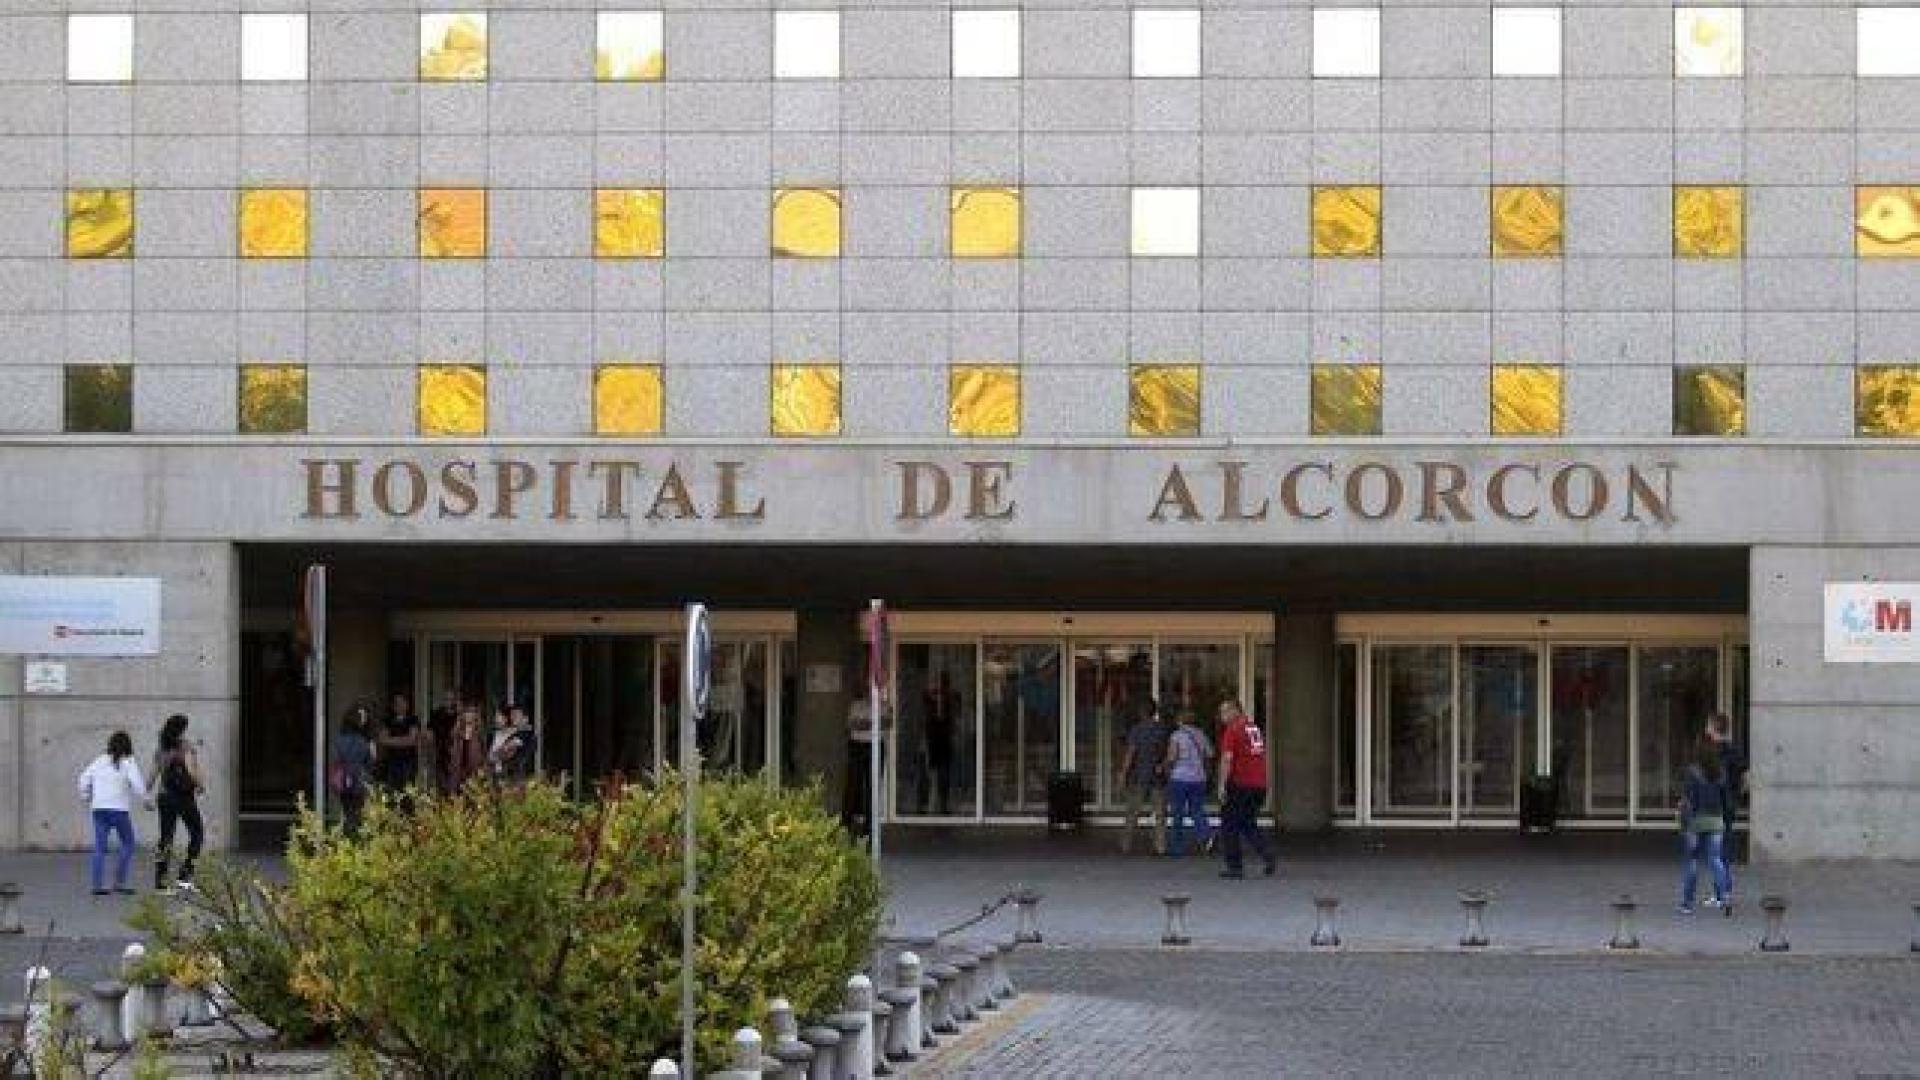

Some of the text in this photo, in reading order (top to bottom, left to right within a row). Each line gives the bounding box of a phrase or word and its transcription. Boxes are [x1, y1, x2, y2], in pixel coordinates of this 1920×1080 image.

[299, 458, 1678, 524] HOSPITAL DE ALCORCON
[1874, 599, 1912, 633] M
